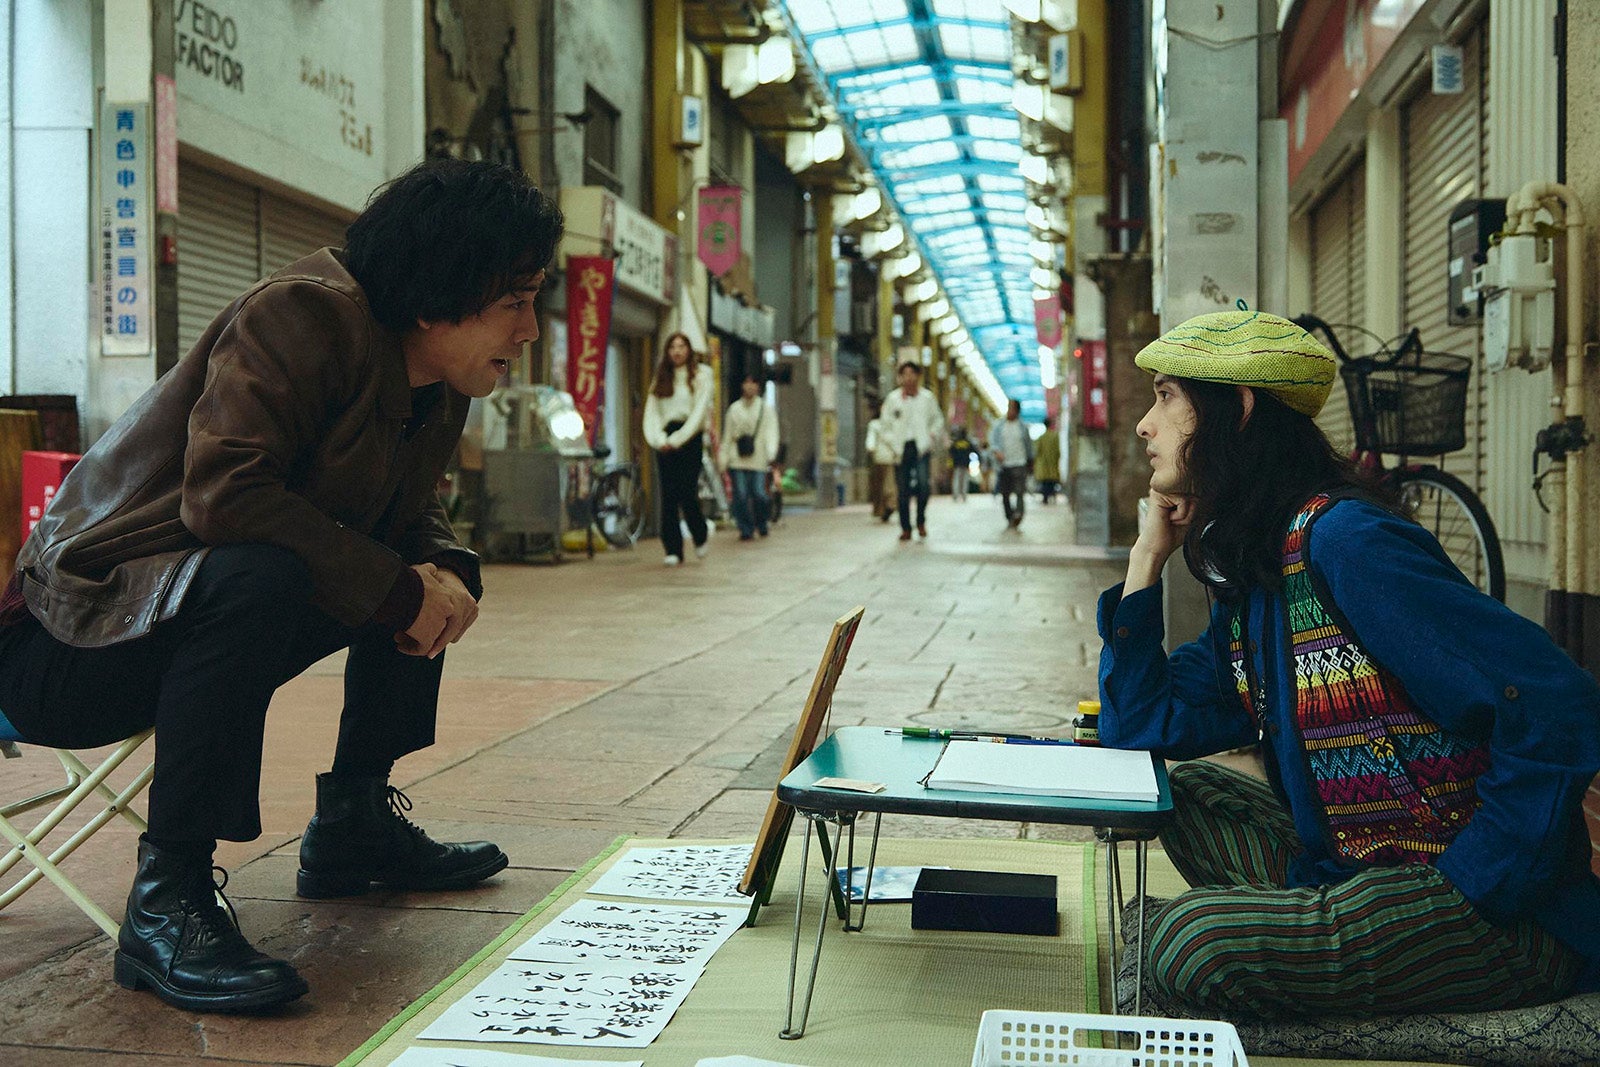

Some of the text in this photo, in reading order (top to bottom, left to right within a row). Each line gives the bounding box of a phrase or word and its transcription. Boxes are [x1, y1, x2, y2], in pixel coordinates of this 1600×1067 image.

[178, 33, 244, 93] FACTOR
[116, 109, 137, 335] 青色申告宣言の街
[575, 265, 607, 403] やきとり
[479, 1023, 637, 1040] 人生は
